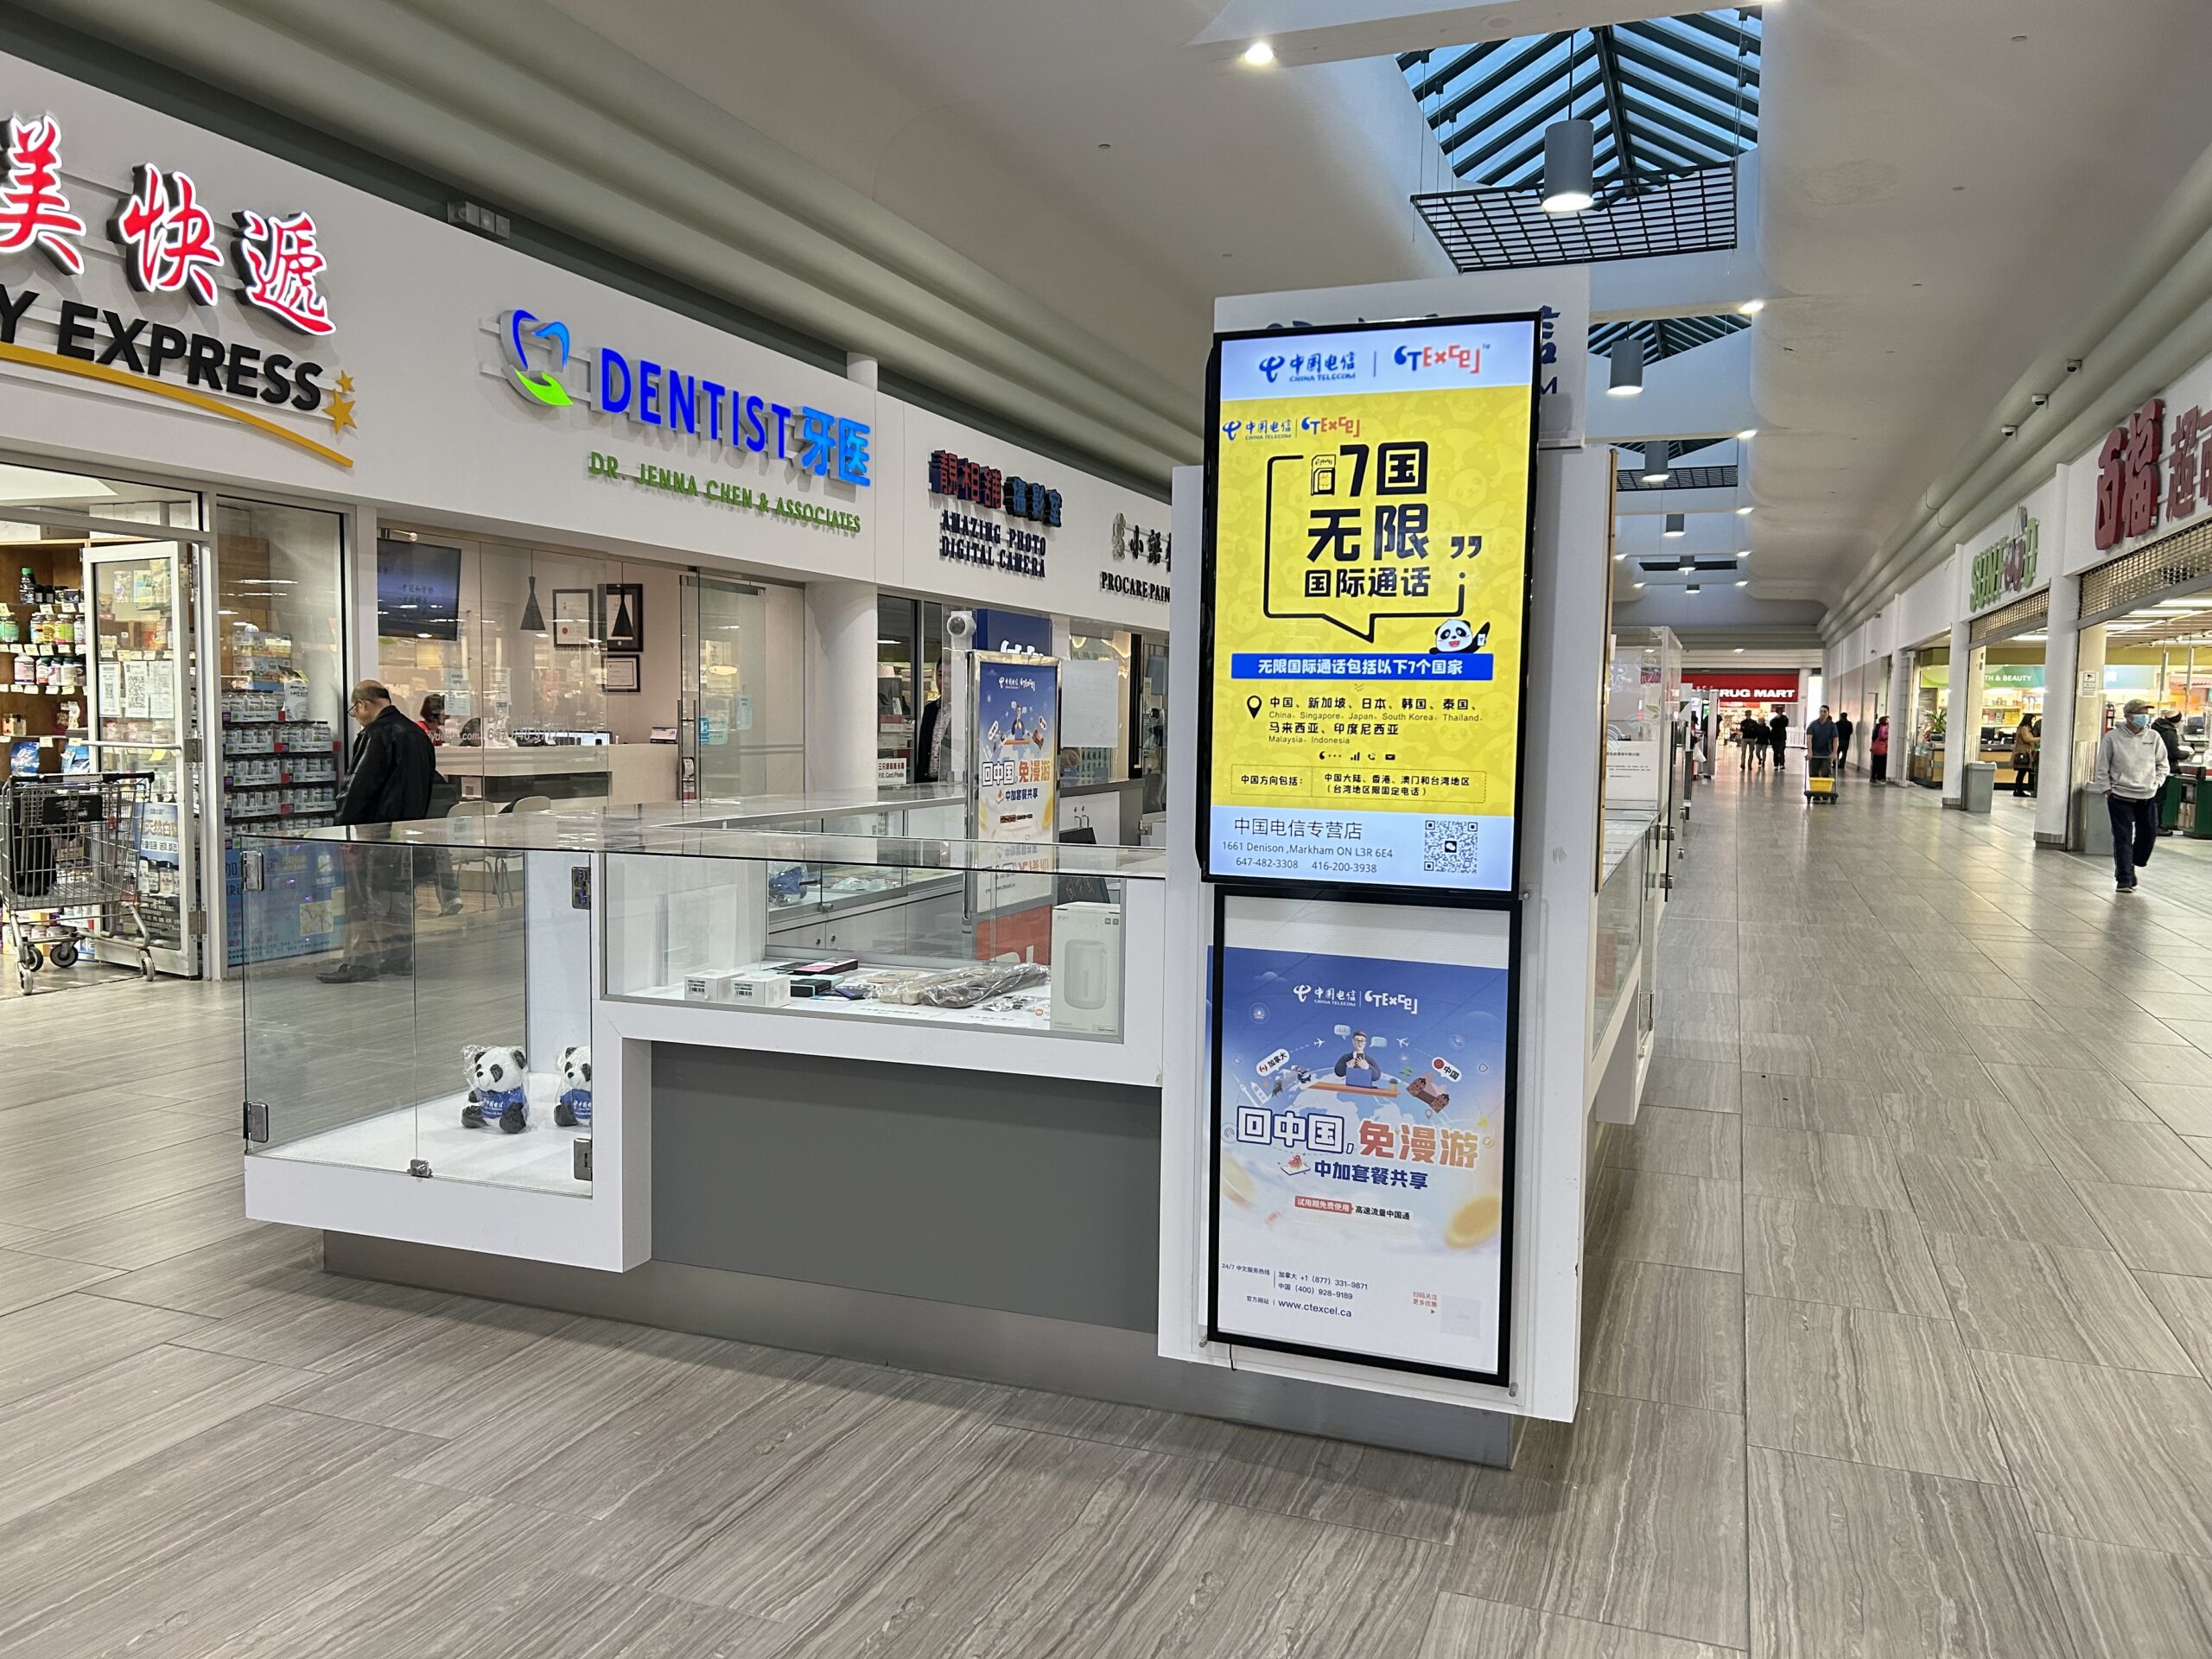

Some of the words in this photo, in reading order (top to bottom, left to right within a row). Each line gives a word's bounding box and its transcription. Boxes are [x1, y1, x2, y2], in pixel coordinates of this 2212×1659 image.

[58, 301, 323, 411] EXPRESS
[1288, 351, 1356, 375] 中国电信
[1317, 372, 1356, 381] TELECOM
[601, 347, 791, 460] DENTIST
[801, 406, 871, 486] 牙医
[1245, 419, 1292, 433] 中国电信
[1339, 442, 1428, 498] 7国
[591, 451, 626, 480] DR.
[637, 463, 698, 496] JENNA
[707, 480, 752, 508] CHEN
[760, 493, 769, 513] &
[776, 496, 861, 532] ASSOCIATES
[942, 510, 1001, 543] AMAZING
[1008, 528, 1046, 556] PHOTO
[1306, 504, 1428, 563] 无限
[942, 536, 994, 566] DIGITAL
[999, 550, 1046, 577] CAMERA
[1101, 572, 1147, 598] PROCARE
[1304, 567, 1431, 598] 国际通话
[1258, 658, 1463, 675] 无限国际通话包括以下7个国家
[1709, 690, 1751, 698] RUG
[1754, 690, 1795, 698] MART
[1312, 736, 1350, 745] Indonesia
[1234, 817, 1363, 840] 中国电信专营店
[1222, 842, 1243, 851] 1661
[1246, 842, 1284, 853] Denison
[1337, 847, 1353, 855] ON
[1355, 847, 1374, 857] L3R
[1376, 849, 1393, 858] 6E4
[1236, 857, 1298, 869] 647-482-3308
[1312, 862, 1377, 873] 416-200-3938
[1314, 987, 1356, 1001] 中国电信
[1267, 1052, 1288, 1069] 加拿大
[1443, 1065, 1460, 1081] 中国
[1313, 1160, 1428, 1190] 中加套餐共享
[1297, 1198, 1350, 1213] 试用期免费使用
[1355, 1205, 1410, 1220] 高速流量中国通
[1236, 1265, 1270, 1275] 中文服务热线
[1279, 1270, 1298, 1281] 加拿大
[1335, 1279, 1369, 1290] 331-9871
[1246, 1295, 1269, 1305] 官方网站
[1278, 1282, 1291, 1291] 中国
[1319, 1289, 1353, 1300] 928-9189
[1278, 1300, 1351, 1318] www.ctexcel.ca
